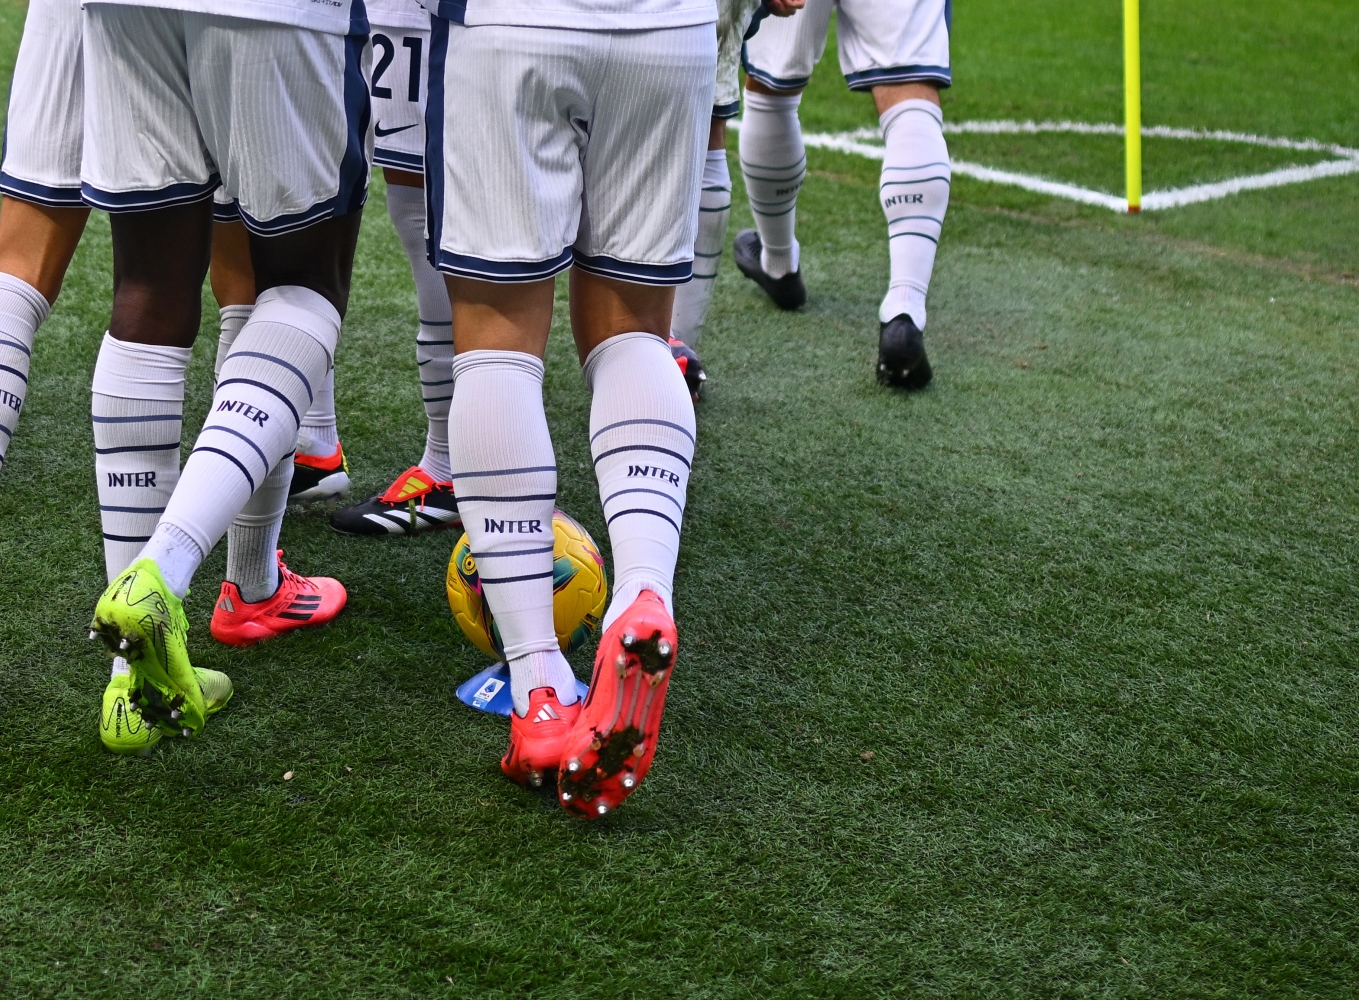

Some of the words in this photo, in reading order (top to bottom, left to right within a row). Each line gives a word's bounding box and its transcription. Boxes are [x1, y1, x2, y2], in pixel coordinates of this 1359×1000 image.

[370, 33, 424, 103] 21
[885, 193, 924, 209] INTER
[216, 399, 270, 428] INTER
[107, 470, 157, 488] INTER
[627, 464, 680, 489] INTER
[484, 517, 543, 534] INTER
